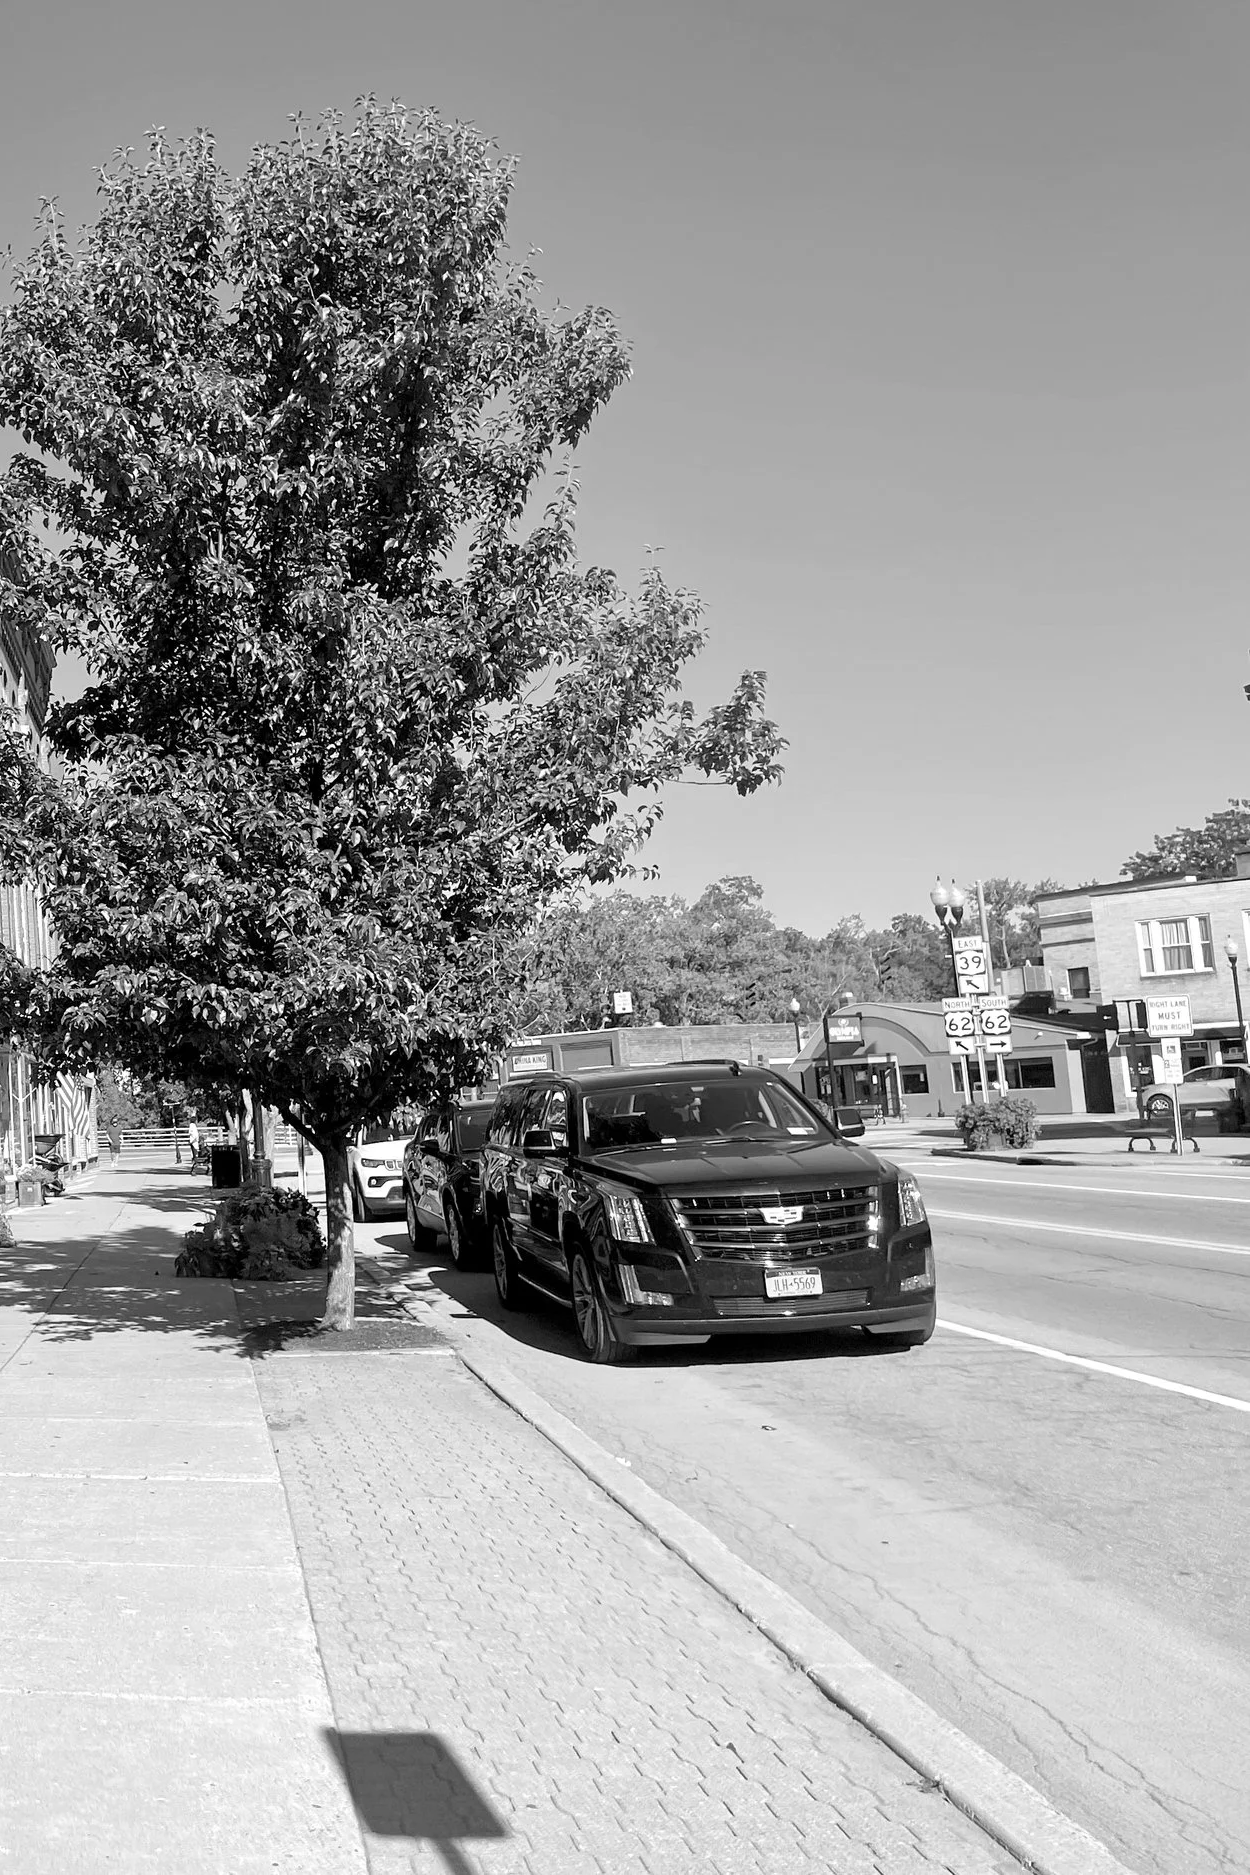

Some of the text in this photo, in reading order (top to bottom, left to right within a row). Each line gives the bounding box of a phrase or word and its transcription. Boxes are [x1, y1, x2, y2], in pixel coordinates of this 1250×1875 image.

[957, 939, 978, 949] EAST
[959, 955, 982, 971] 39
[944, 1000, 971, 1009] NORTH
[981, 998, 1007, 1006] SOUTH
[1149, 1000, 1188, 1009] RIGHT LANE
[1158, 1011, 1181, 1020] MUST
[948, 1017, 972, 1032] 62
[984, 1014, 1009, 1030] 62
[1151, 1023, 1190, 1032] TURN RIGHT
[532, 1055, 547, 1064] KING
